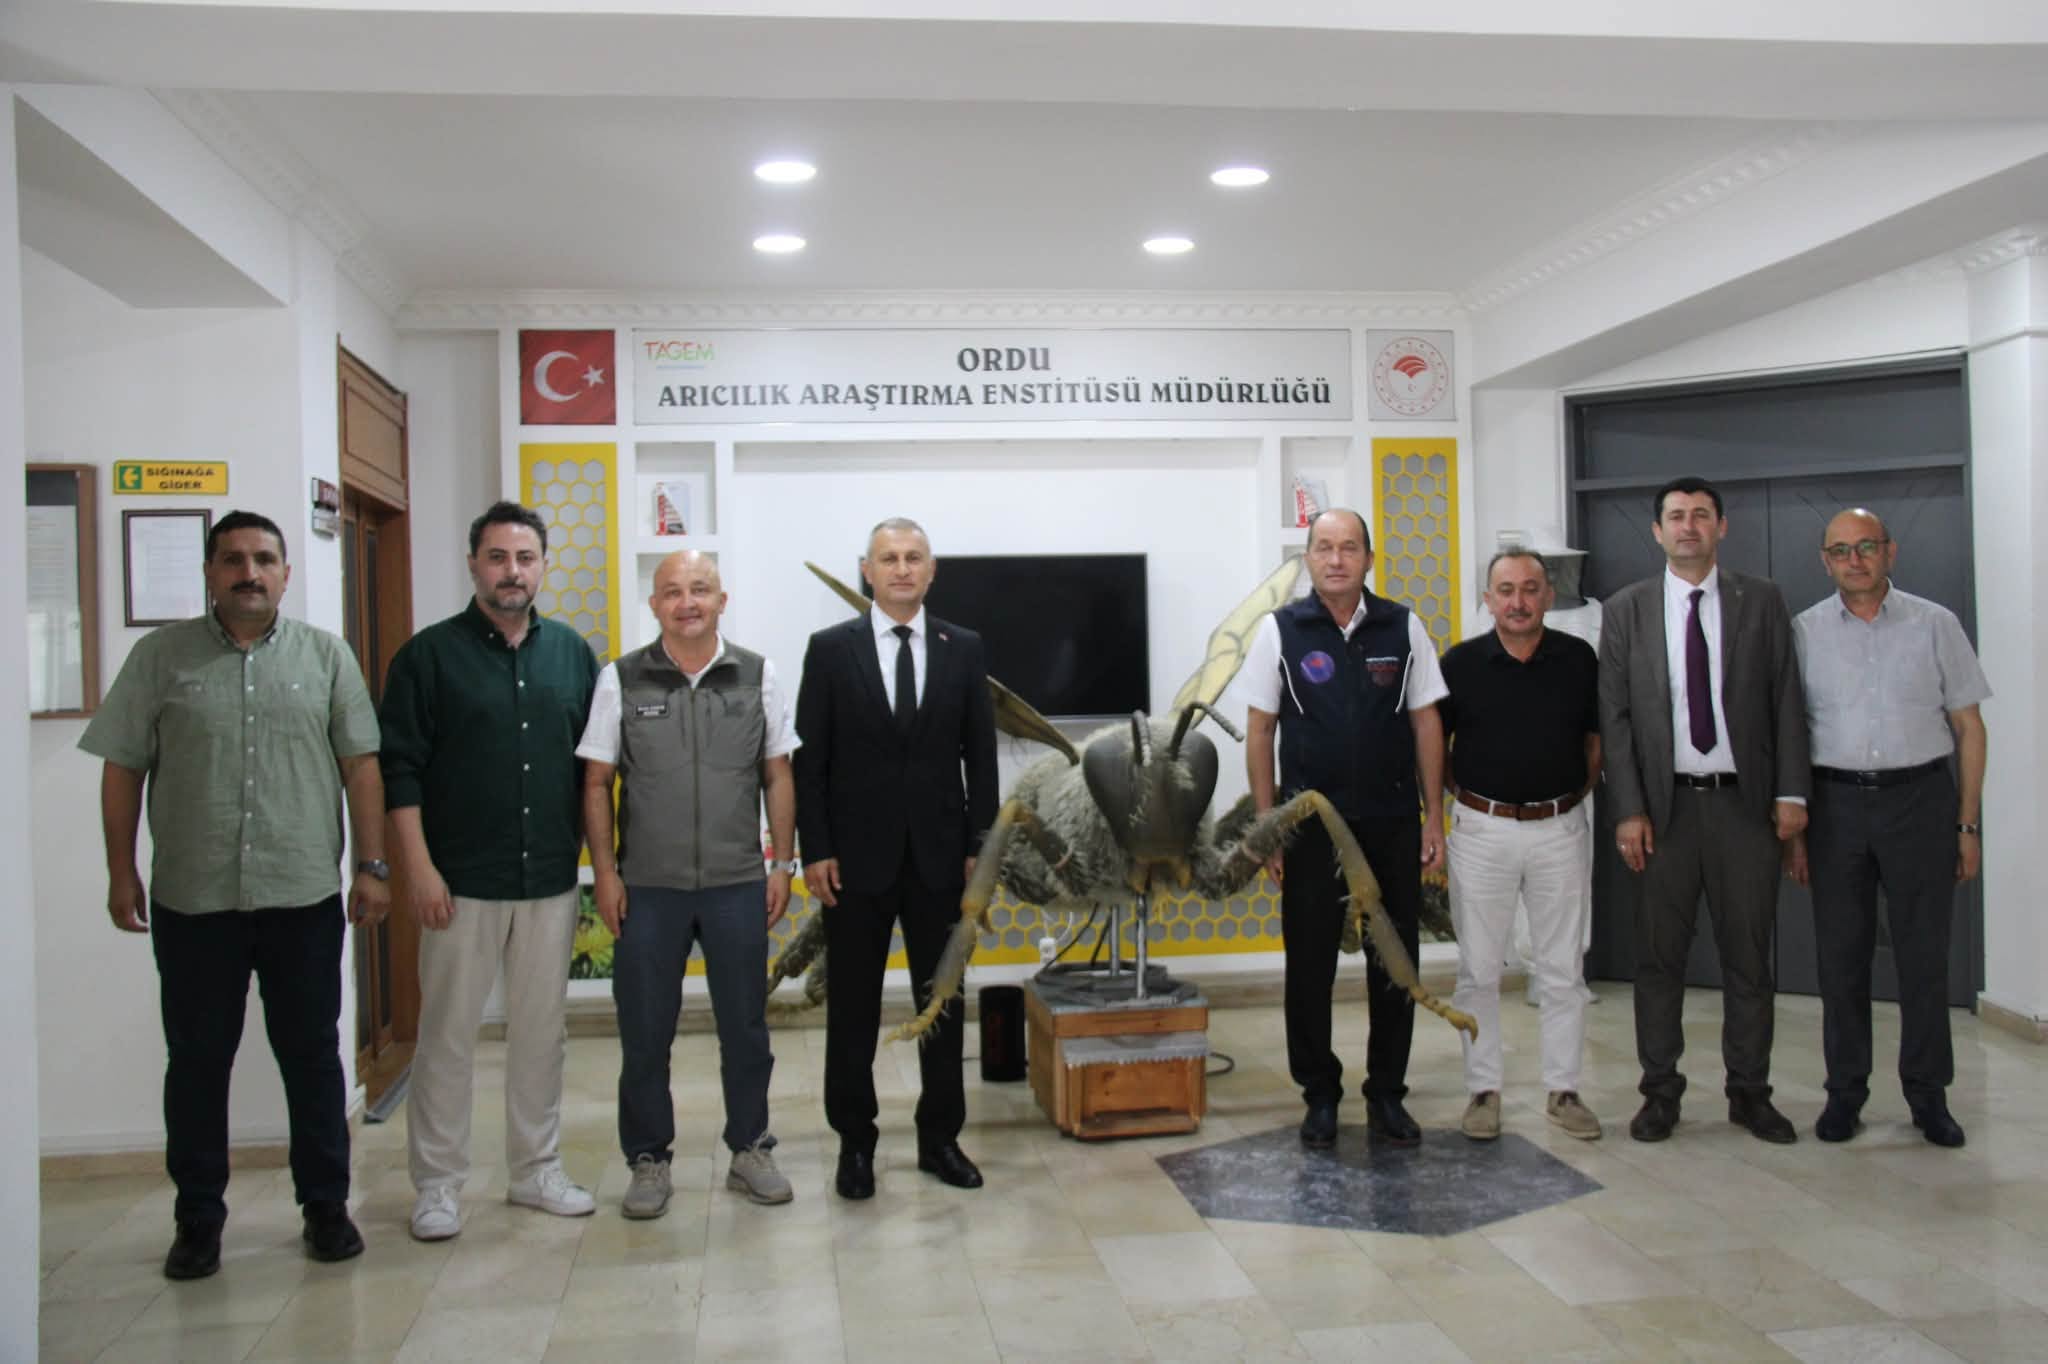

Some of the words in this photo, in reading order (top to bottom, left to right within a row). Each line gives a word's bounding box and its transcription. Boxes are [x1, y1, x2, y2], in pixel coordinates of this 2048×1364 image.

[644, 341, 715, 361] TAGEM
[957, 347, 1051, 372] ORDU
[658, 383, 791, 407] ARICILIK
[799, 383, 974, 411] ARAŞTIRMA
[982, 376, 1141, 405] ENSTİTÜSÜ
[1151, 376, 1332, 403] MÜDÜRLÜĞÜ
[146, 465, 215, 477] SIĞINAĞA
[158, 479, 203, 490] GİDER
